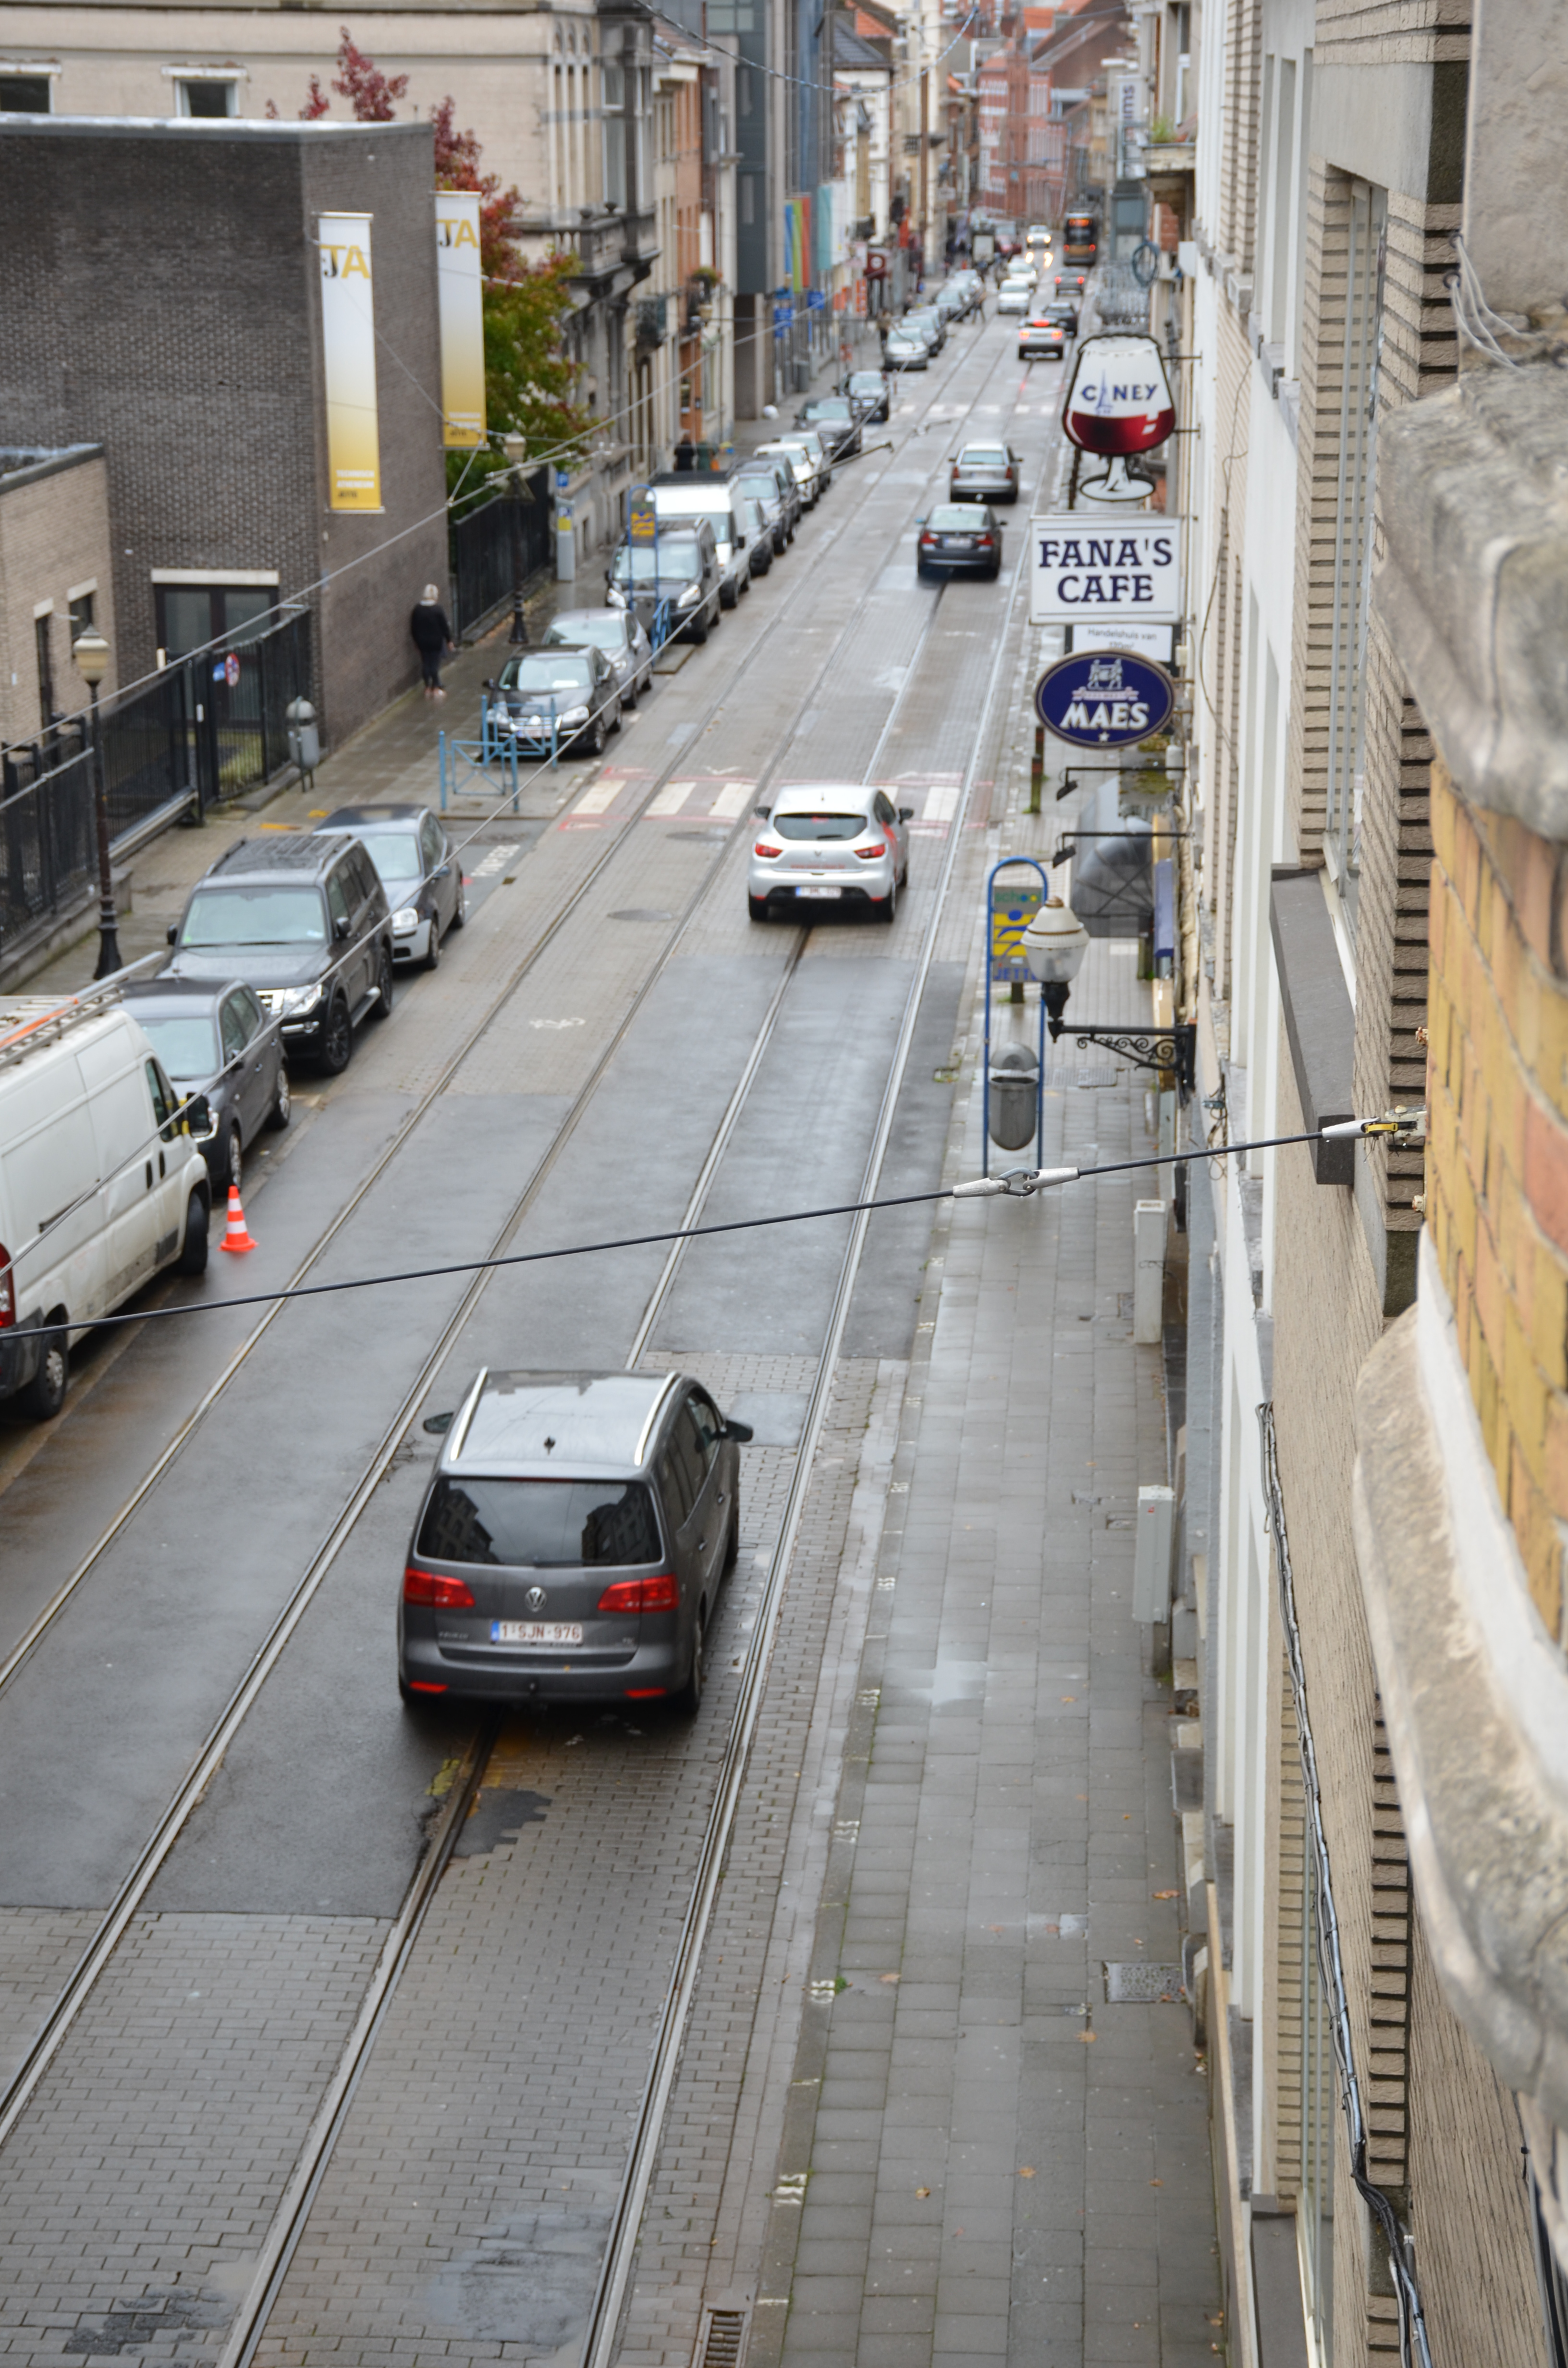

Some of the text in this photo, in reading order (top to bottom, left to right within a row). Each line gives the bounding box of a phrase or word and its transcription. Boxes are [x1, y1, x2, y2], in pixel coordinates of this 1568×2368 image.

[1039, 538, 1173, 567] FANA'S
[1057, 575, 1154, 604] CAFE
[1059, 702, 1150, 730] MAES
